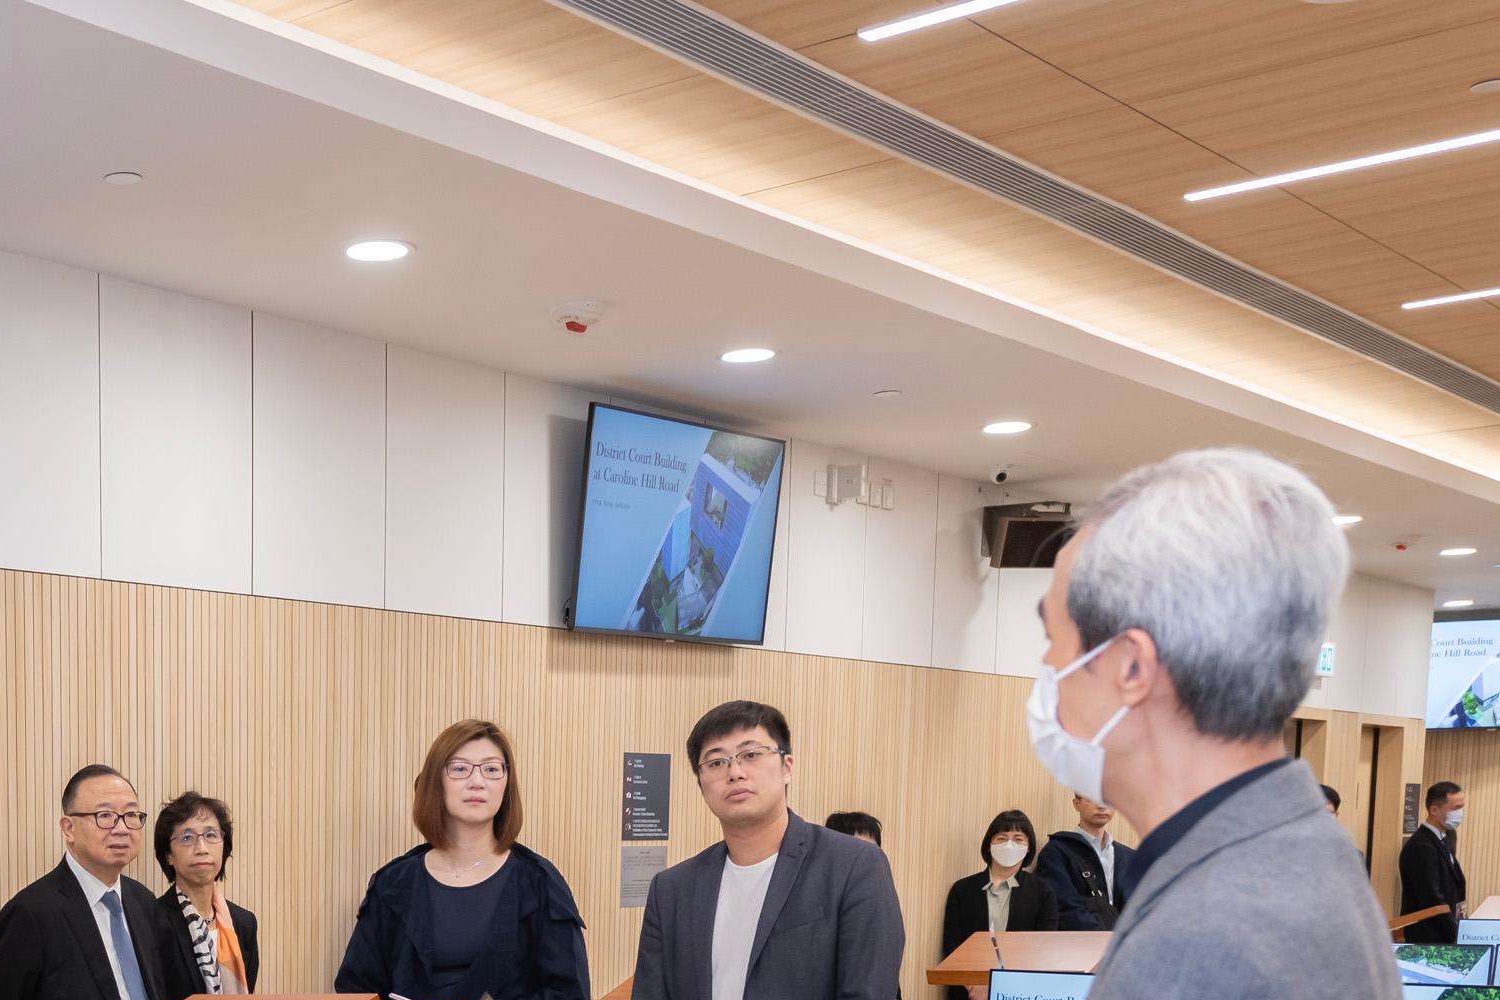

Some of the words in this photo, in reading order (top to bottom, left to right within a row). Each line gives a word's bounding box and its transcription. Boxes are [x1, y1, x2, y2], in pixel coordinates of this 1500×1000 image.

[596, 441, 626, 461] District
[628, 447, 652, 465] Court
[654, 451, 688, 473] Building
[603, 466, 639, 486] Caroline
[640, 472, 657, 489] Hill
[659, 476, 680, 493] Road
